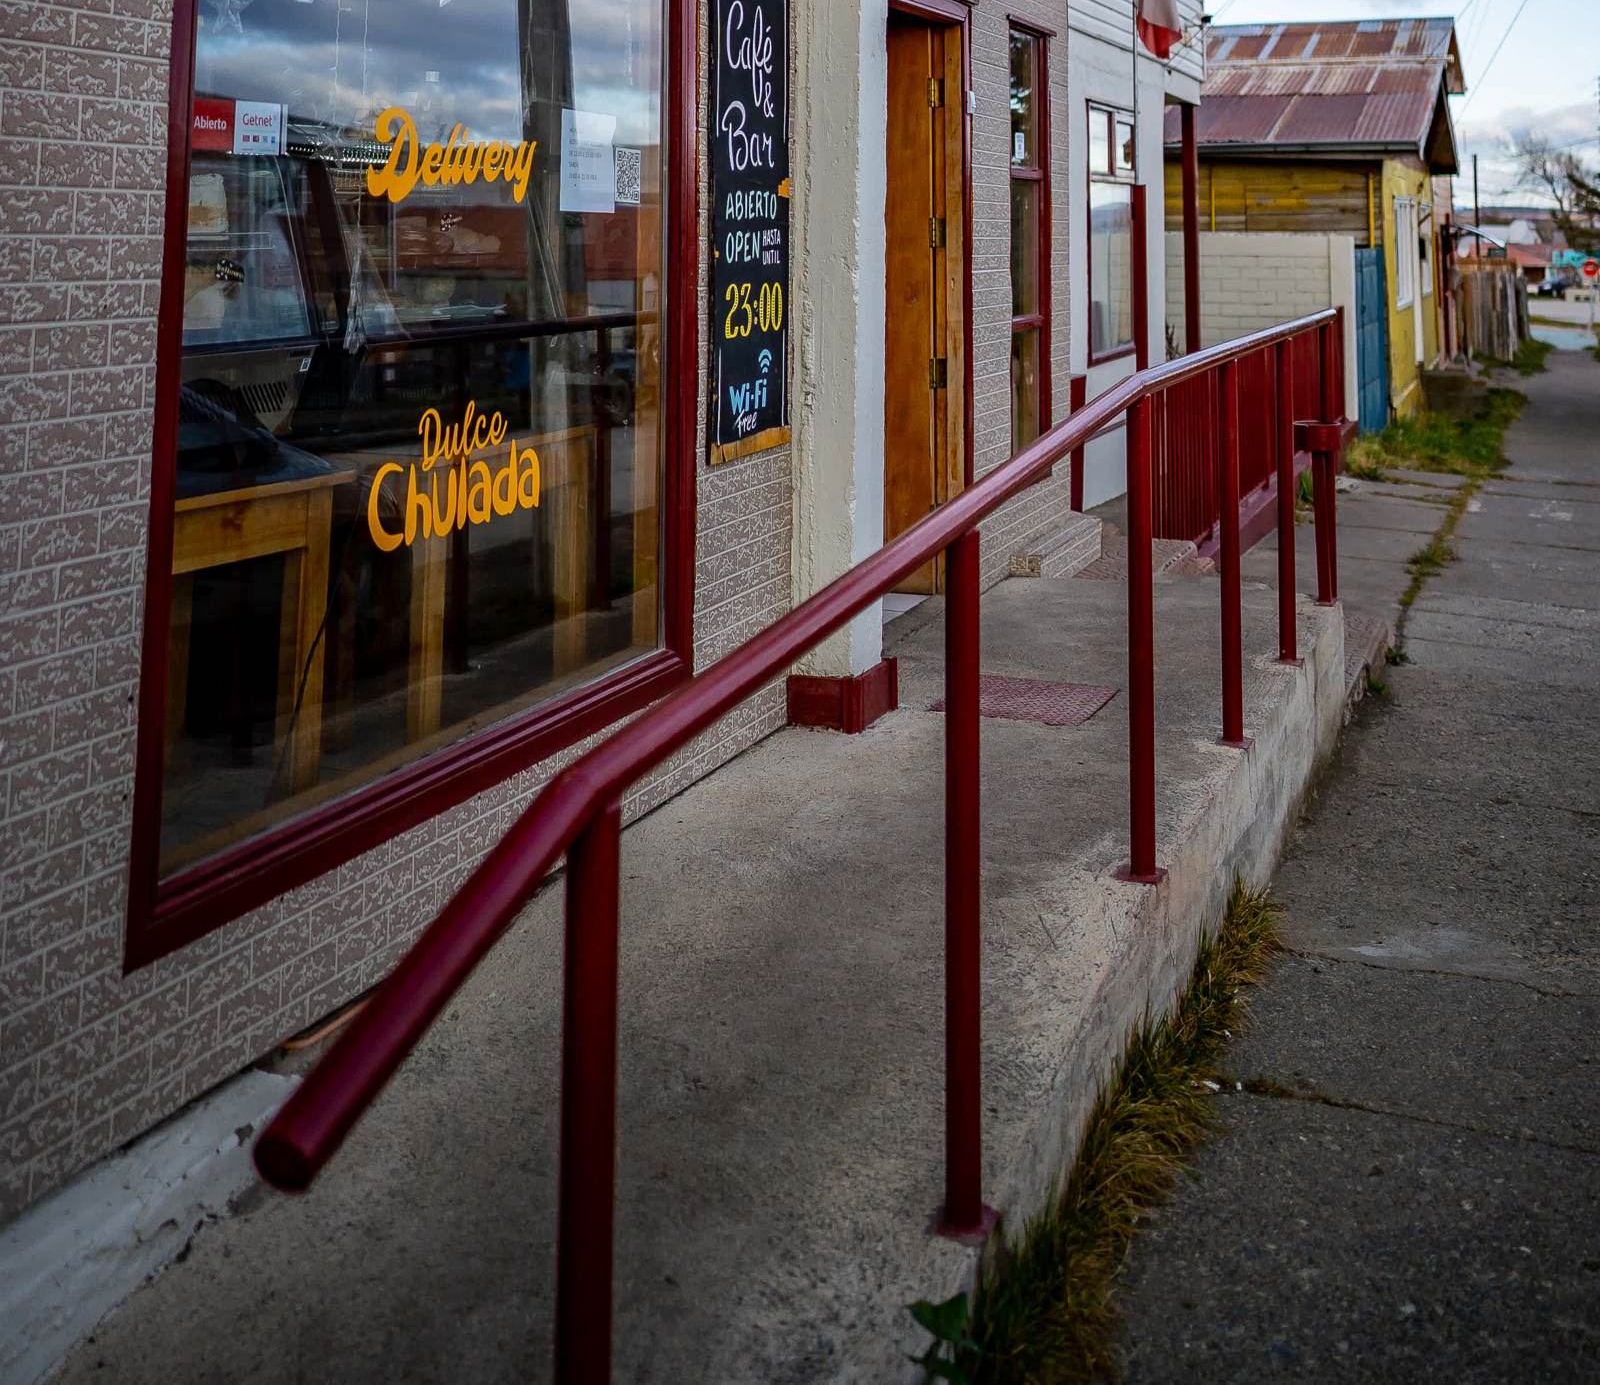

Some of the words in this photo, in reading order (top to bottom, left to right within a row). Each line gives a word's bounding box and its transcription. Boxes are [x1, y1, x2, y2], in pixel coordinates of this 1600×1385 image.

[726, 0, 773, 107] Café
[763, 81, 774, 118] &
[194, 115, 227, 130] Abierto
[243, 113, 272, 127] Getnet
[721, 100, 775, 172] Bar
[367, 106, 538, 204] Delivery
[725, 190, 778, 221] ABIERTO
[725, 230, 761, 263] OPEN
[762, 228, 781, 246] HASTA
[762, 250, 781, 265] UNTIL
[725, 281, 783, 339] 23:00
[418, 400, 507, 471] Dulce
[734, 409, 758, 438] Free
[368, 440, 540, 552] Chulada
